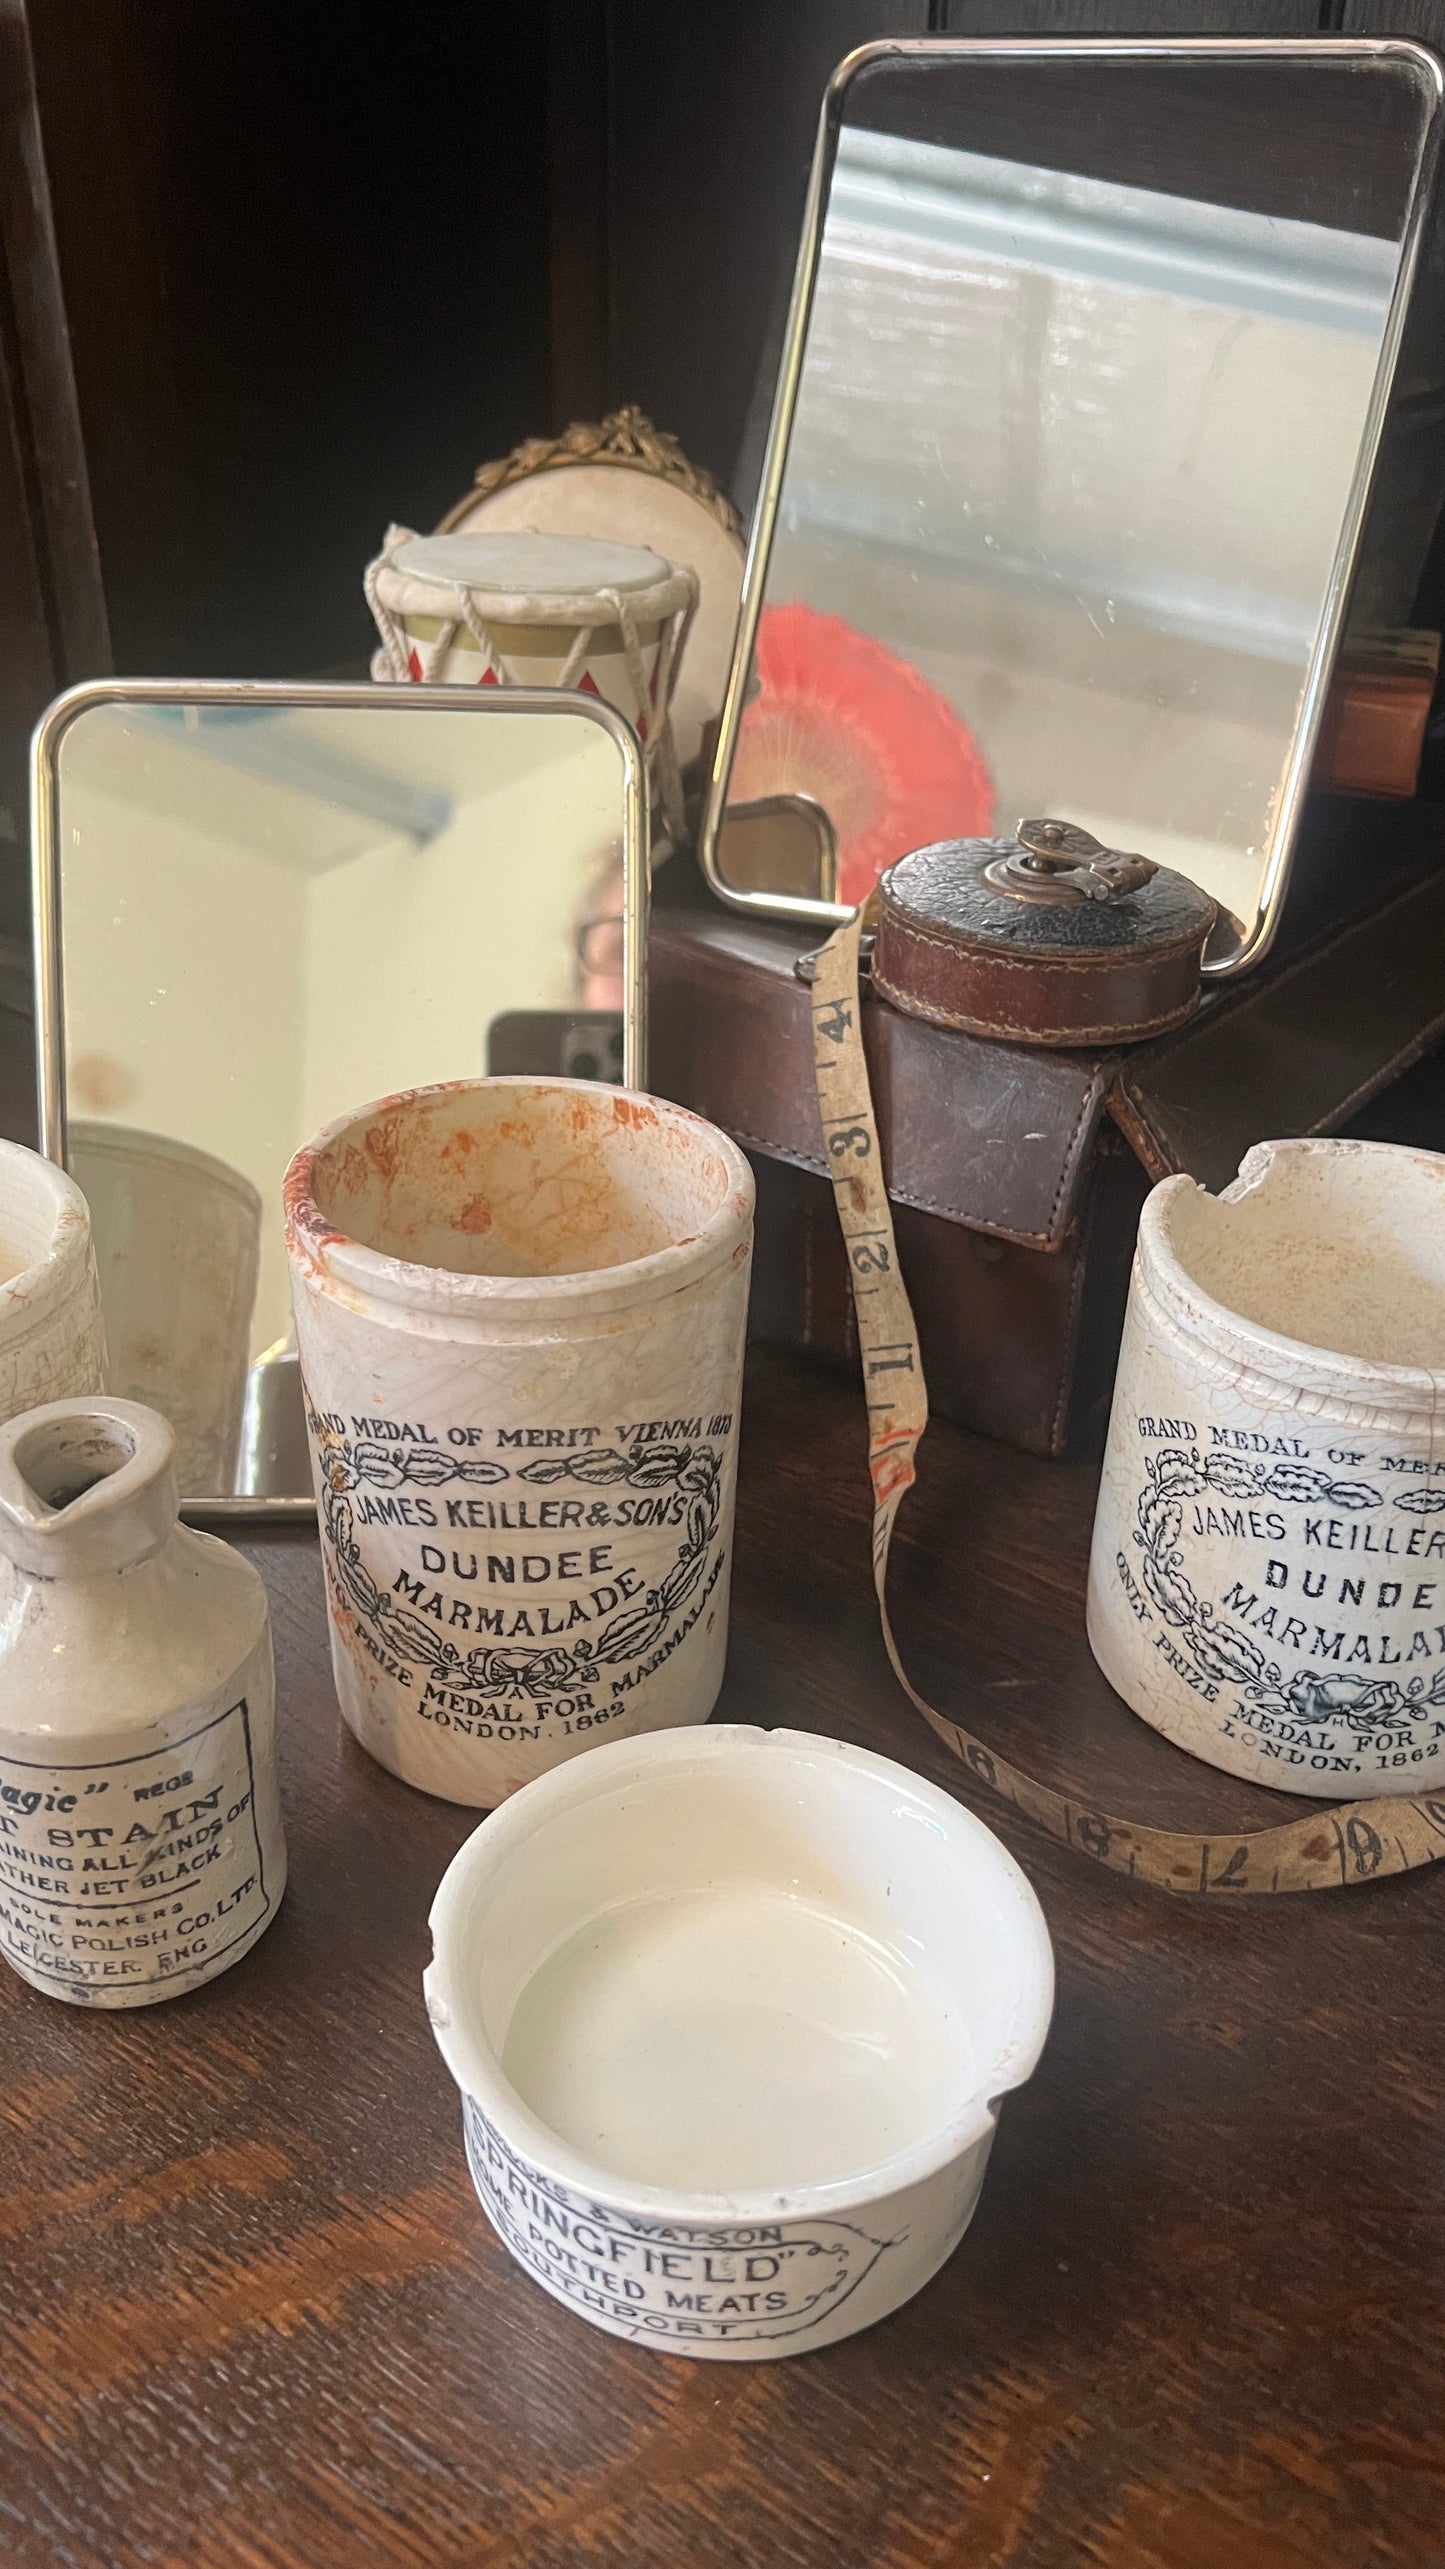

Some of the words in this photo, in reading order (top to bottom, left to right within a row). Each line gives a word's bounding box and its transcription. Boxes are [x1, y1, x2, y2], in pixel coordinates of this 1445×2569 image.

[817, 1003, 853, 1044] 4
[829, 1127, 871, 1157] 3
[853, 1243, 888, 1274] 2
[354, 1415, 438, 1444] MEDAL
[448, 1426, 482, 1446] OF
[497, 1426, 601, 1448] MERIT
[615, 1416, 702, 1443] VIENNA
[1138, 1417, 1197, 1441] GRAND
[1207, 1425, 1309, 1458] MEDAL
[1327, 1449, 1366, 1466] OF
[356, 1498, 438, 1528] JAMES
[1192, 1506, 1286, 1541] JAMES
[421, 1544, 613, 1583] DUNDEE
[391, 1566, 646, 1637] MARMALADE
[1265, 1559, 1437, 1610] DUNDE
[354, 1622, 413, 1687] PRIZE
[422, 1684, 523, 1721] MEDAL
[536, 1687, 596, 1720] FOR
[1116, 1551, 1152, 1623] ONLY
[1153, 1631, 1220, 1703] PRIZE
[1233, 1701, 1336, 1751] MEDAL
[1352, 1731, 1416, 1754] FOR
[1375, 1743, 1438, 1770] 1862
[0, 1841, 73, 1872] INING
[82, 1854, 138, 1872] ALL
[144, 1818, 223, 1864] KINDS
[227, 1791, 250, 1822] OF
[48, 1785, 224, 1848] STAIN
[0, 1862, 70, 1894] THER
[80, 1879, 130, 1896] JET
[140, 1844, 221, 1889] BLACK
[10, 1897, 62, 1925] SOLE
[75, 1903, 184, 1928] MAKERS
[72, 1928, 167, 1951] POLISH
[630, 2221, 783, 2244] WATSON
[529, 2222, 645, 2301] POTTED
[665, 2290, 788, 2313] MEATS
